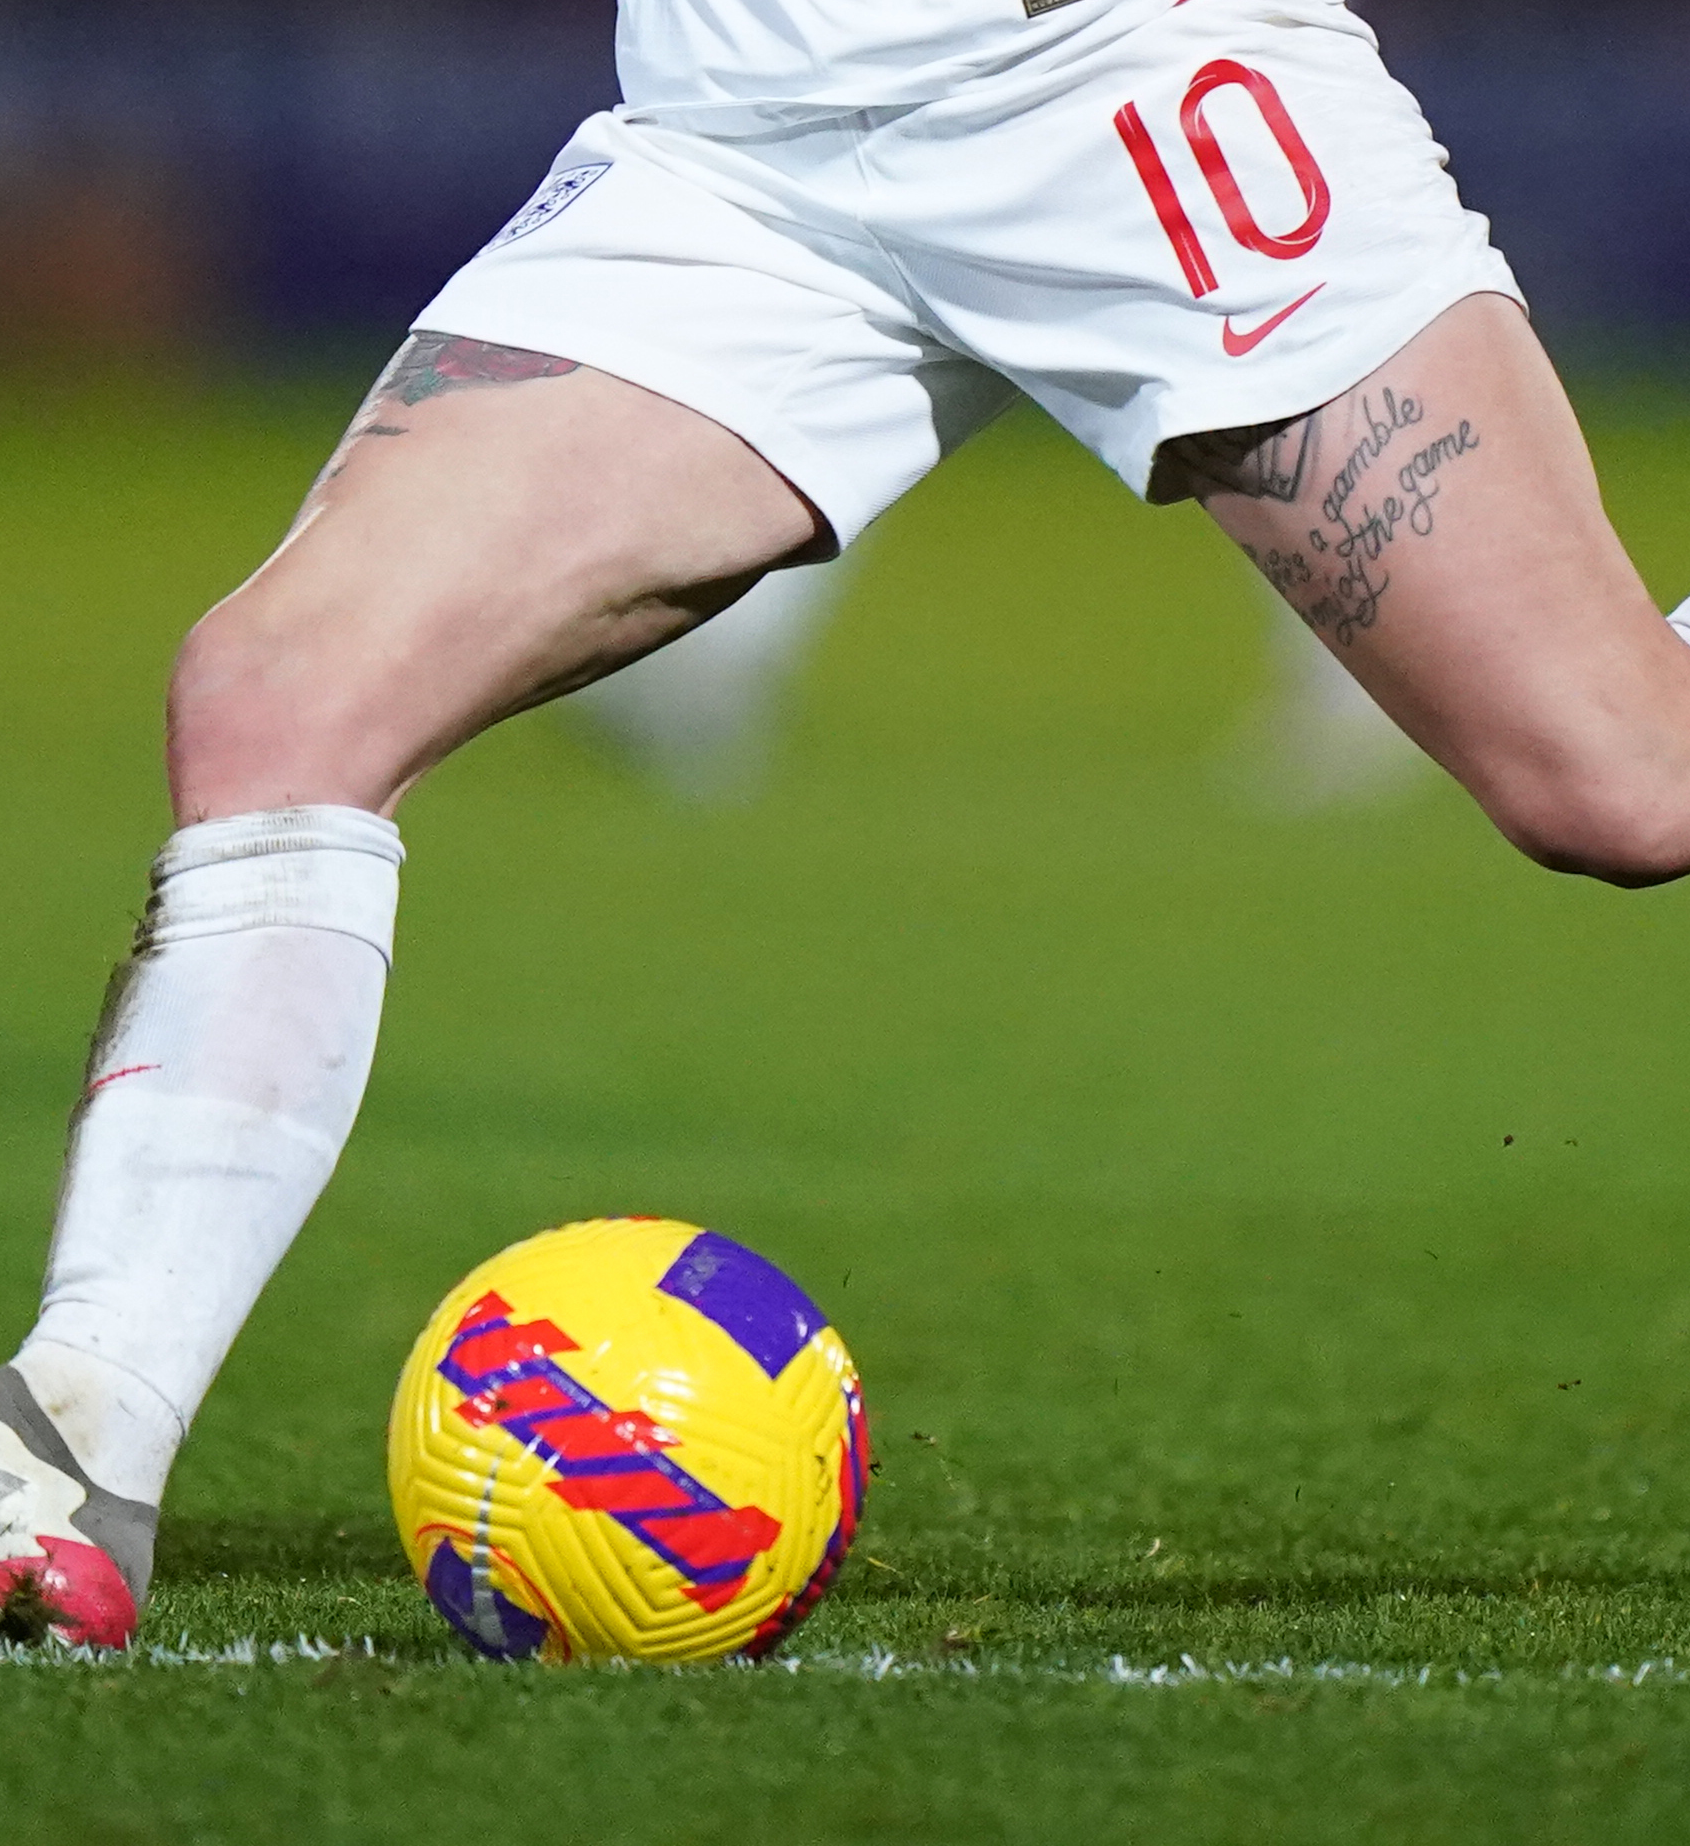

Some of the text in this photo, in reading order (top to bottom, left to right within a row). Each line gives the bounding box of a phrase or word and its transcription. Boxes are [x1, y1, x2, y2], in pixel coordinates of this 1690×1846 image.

[1113, 58, 1332, 300] 10
[1322, 386, 1424, 558] gamble
[1357, 495, 1405, 561] the
[1398, 418, 1480, 536] game
